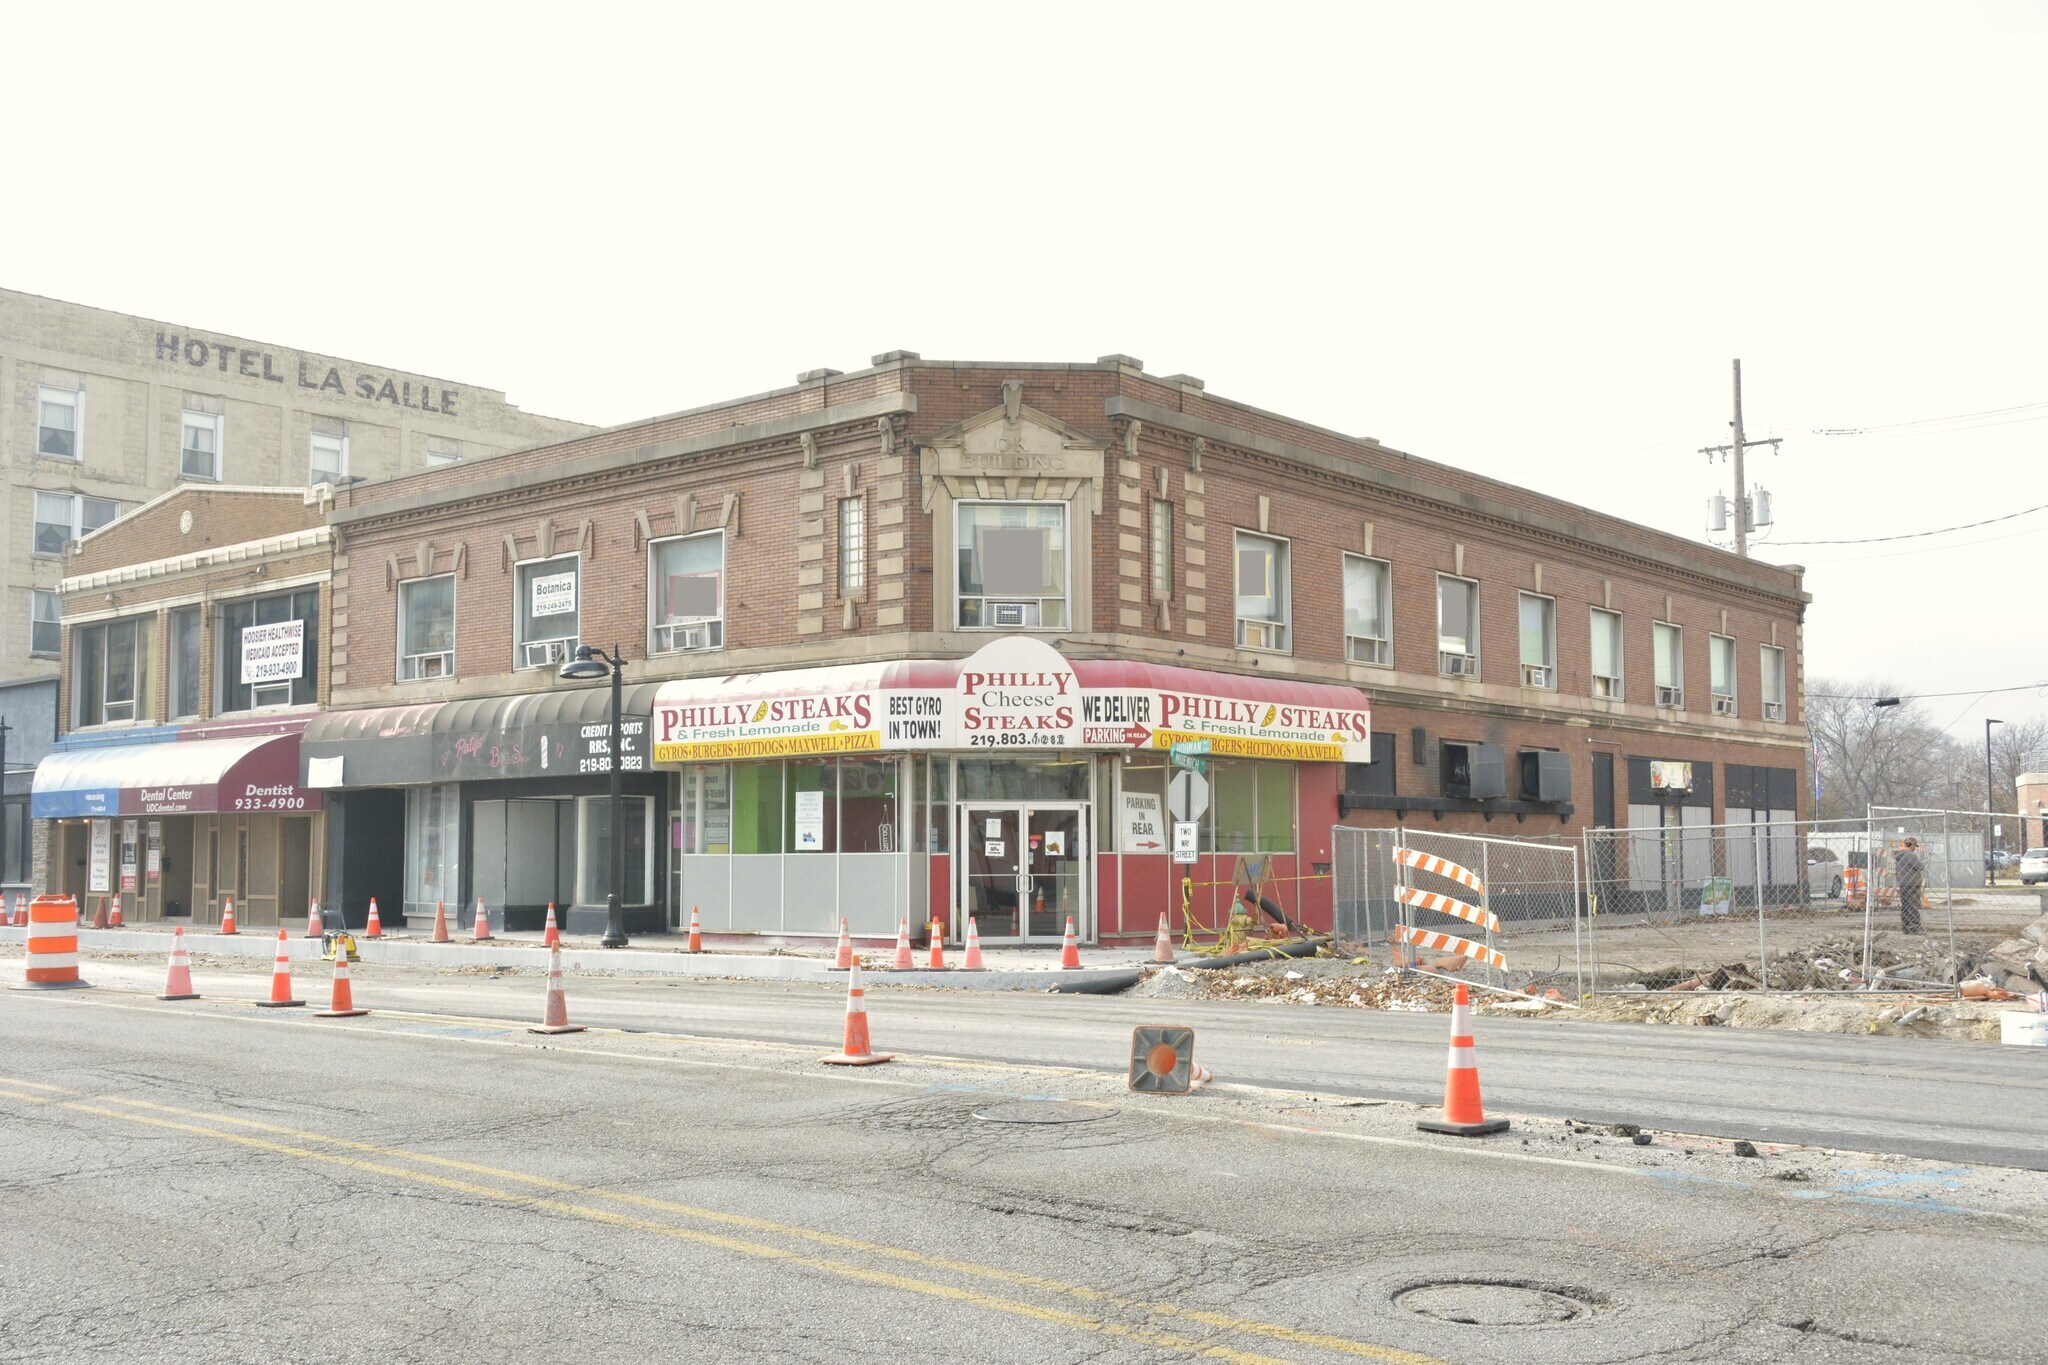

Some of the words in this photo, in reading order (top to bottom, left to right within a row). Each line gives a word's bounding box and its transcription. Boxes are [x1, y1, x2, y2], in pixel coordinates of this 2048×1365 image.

[155, 332, 284, 383] HOTEL
[298, 361, 346, 395] LA
[354, 373, 459, 416] SALLE
[961, 455, 1064, 470] BUILDING
[536, 581, 572, 595] Botanica
[244, 629, 267, 644] HOOSIER
[268, 624, 302, 641] HEALTHWISE
[245, 646, 271, 661] MEDICAID
[271, 642, 300, 657] ACCEPTED
[255, 661, 297, 678] 219-933-4900
[963, 672, 1073, 695] PHILLY
[889, 696, 915, 716] BEST
[916, 696, 942, 716] GYRO
[982, 690, 1055, 707] Cheese
[660, 703, 752, 742] PHILLY
[770, 693, 872, 730] STEAKS
[964, 706, 1074, 730] STEAKS
[1082, 696, 1101, 722] WE
[1104, 696, 1150, 723] DELIVER
[1158, 693, 1260, 728] PHILLY
[1280, 707, 1367, 743] STEAKS
[580, 724, 608, 738] CREDIT
[677, 730, 688, 740] &
[693, 727, 735, 740] Fresh
[739, 721, 821, 737] Lemonade
[889, 721, 900, 740] IN
[903, 720, 941, 739] TOWN!
[1085, 727, 1126, 743] PARKING
[1183, 719, 1196, 730] &
[1201, 720, 1246, 736] Fresh
[1250, 725, 1325, 741] Lemonade
[589, 740, 611, 755] RRS,
[659, 745, 689, 760] GYROS
[692, 743, 733, 759] BURGERS
[737, 739, 784, 756] HOTDOGS
[788, 736, 839, 754] MAXWELL
[844, 734, 875, 750] PIZZA
[1199, 736, 1243, 753] RGERS
[1247, 743, 1292, 757] HOTDOGS
[1294, 746, 1339, 760] MAXWELL
[141, 788, 166, 801] Dental
[167, 787, 193, 801] Center
[245, 784, 294, 796] Dentist
[146, 803, 187, 813] UDCdental.com
[234, 797, 305, 810] 933-4900
[1126, 796, 1156, 810] PARKING
[1138, 812, 1146, 821] IN
[1132, 822, 1154, 835] REAR
[1180, 827, 1192, 835] TWO
[1181, 839, 1190, 847] WAY
[1175, 850, 1195, 859] STREET
